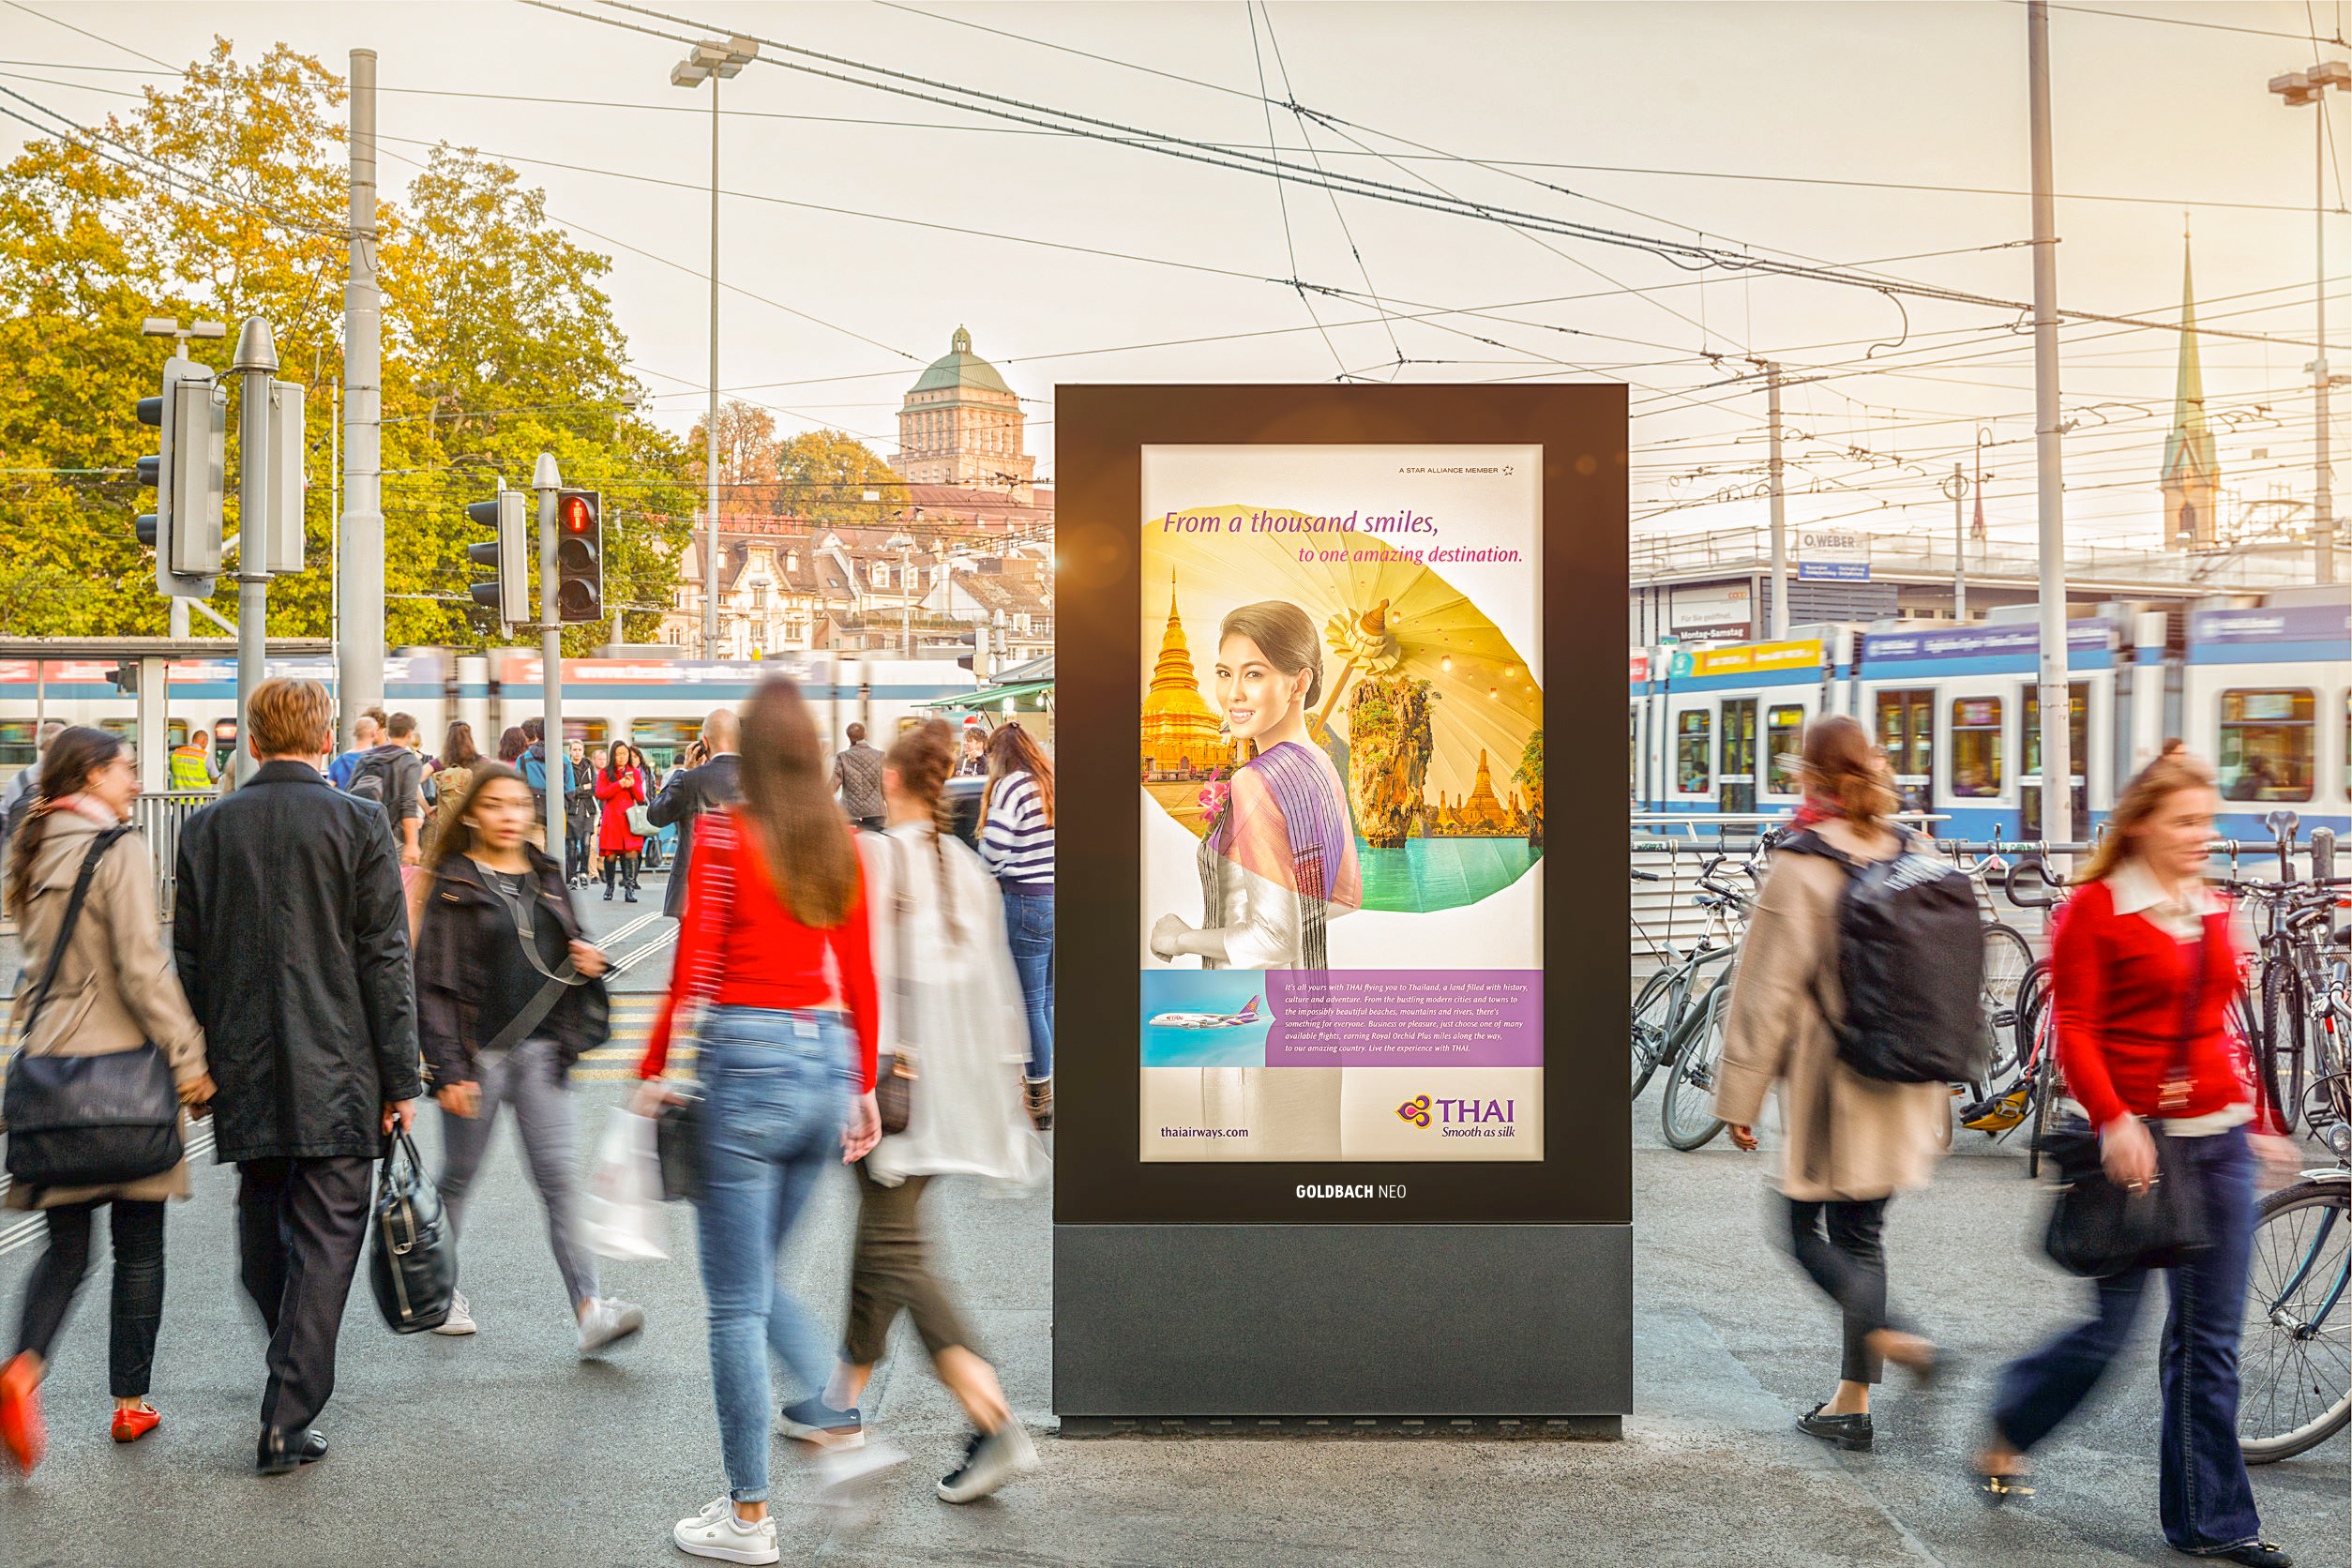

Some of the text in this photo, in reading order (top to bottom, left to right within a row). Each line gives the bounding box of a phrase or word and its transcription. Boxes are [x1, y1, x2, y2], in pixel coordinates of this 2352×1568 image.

[1163, 510, 1440, 537] From a thousand smiles,
[1298, 545, 1523, 566] to one amazing destination.
[1680, 627, 1744, 641] Montag-Samstag
[1285, 983, 1296, 991] It's
[1296, 983, 1307, 991] all
[1306, 985, 1327, 993] yours
[1328, 983, 1344, 991] with
[1346, 983, 1364, 991] THAI
[1364, 983, 1384, 993] flying
[1384, 985, 1398, 993] you
[1399, 983, 1407, 991] to
[1409, 983, 1441, 992] Thailand,
[1449, 983, 1466, 991] land
[1466, 983, 1485, 993] filled
[1485, 983, 1501, 991] with
[1502, 983, 1529, 993] history,
[1285, 995, 1518, 1005] culture and adventure. From the bustling modern cities and towns to
[1285, 1007, 1500, 1018] the impossibly beautiful beaches, mountains and rivers, there's
[1285, 1019, 1321, 1030] something
[1320, 1019, 1333, 1030] for
[1334, 1021, 1366, 1030] everyone.
[1368, 1019, 1397, 1028] Business
[1407, 1019, 1439, 1030] pleasure,
[1440, 1019, 1454, 1030] just
[1455, 1019, 1479, 1028] choose
[1493, 1019, 1502, 1030] of
[1503, 1021, 1524, 1030] many
[1285, 1032, 1502, 1042] available flights, earning Royal Orchid Plus miles along the way,
[1285, 1044, 1293, 1052] to
[1307, 1044, 1338, 1054] amazing
[1338, 1044, 1366, 1054] country.
[1368, 1044, 1383, 1052] Live
[1383, 1044, 1395, 1052] the
[1396, 1044, 1433, 1054] experience
[1434, 1044, 1450, 1052] with
[1452, 1044, 1470, 1052] THAI.
[1434, 1098, 1515, 1123] THAI
[1160, 1126, 1249, 1139] thaiairways.com
[1440, 1125, 1515, 1138] Smooth as silk
[1295, 1184, 1407, 1199] GOLDBACH NEO
